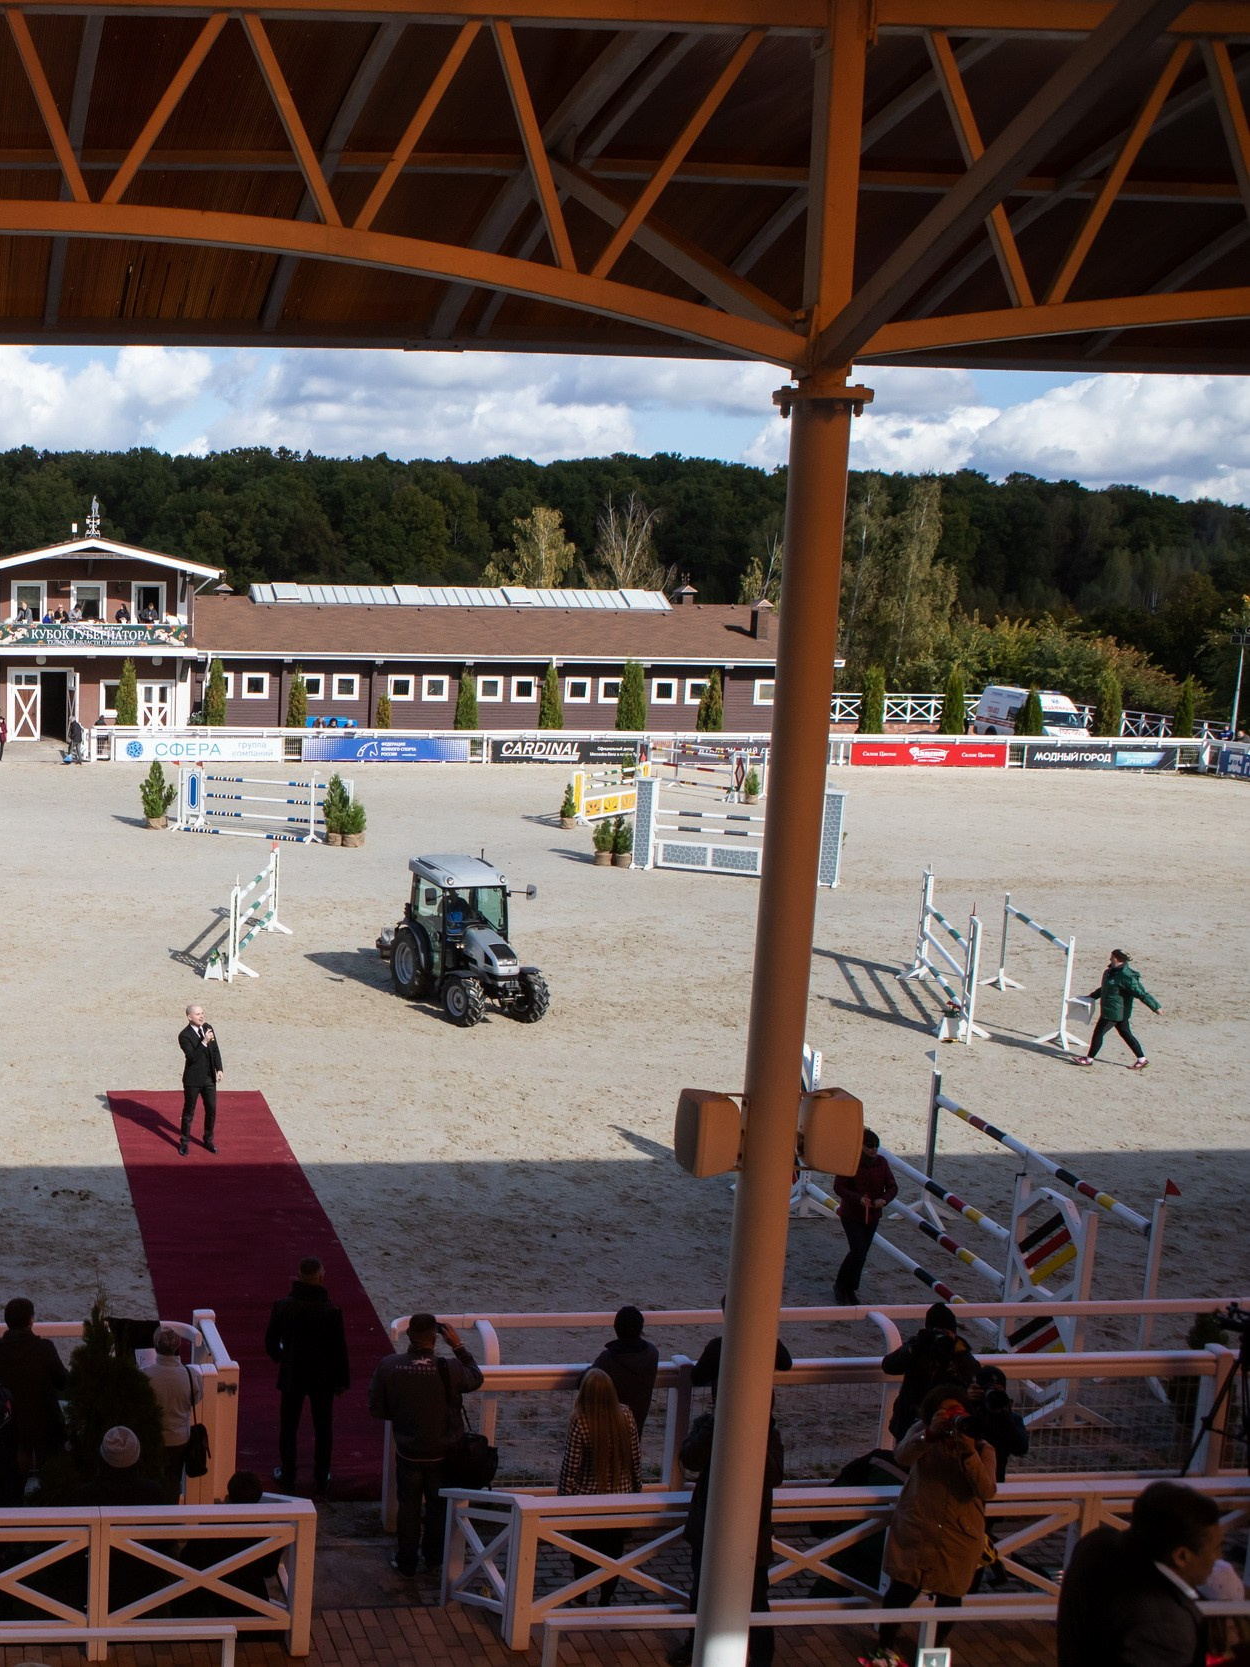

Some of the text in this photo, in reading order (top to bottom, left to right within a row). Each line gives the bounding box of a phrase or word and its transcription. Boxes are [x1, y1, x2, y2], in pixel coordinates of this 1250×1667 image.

[31, 629, 151, 641] КУБОК ГУБЕРНАТОРА
[155, 742, 221, 757] СФЕРА
[238, 742, 267, 750] группа
[501, 742, 581, 755] CARDINAL
[1034, 751, 1079, 762] МОДНЫЙ
[1079, 753, 1112, 763] ГОРОД
